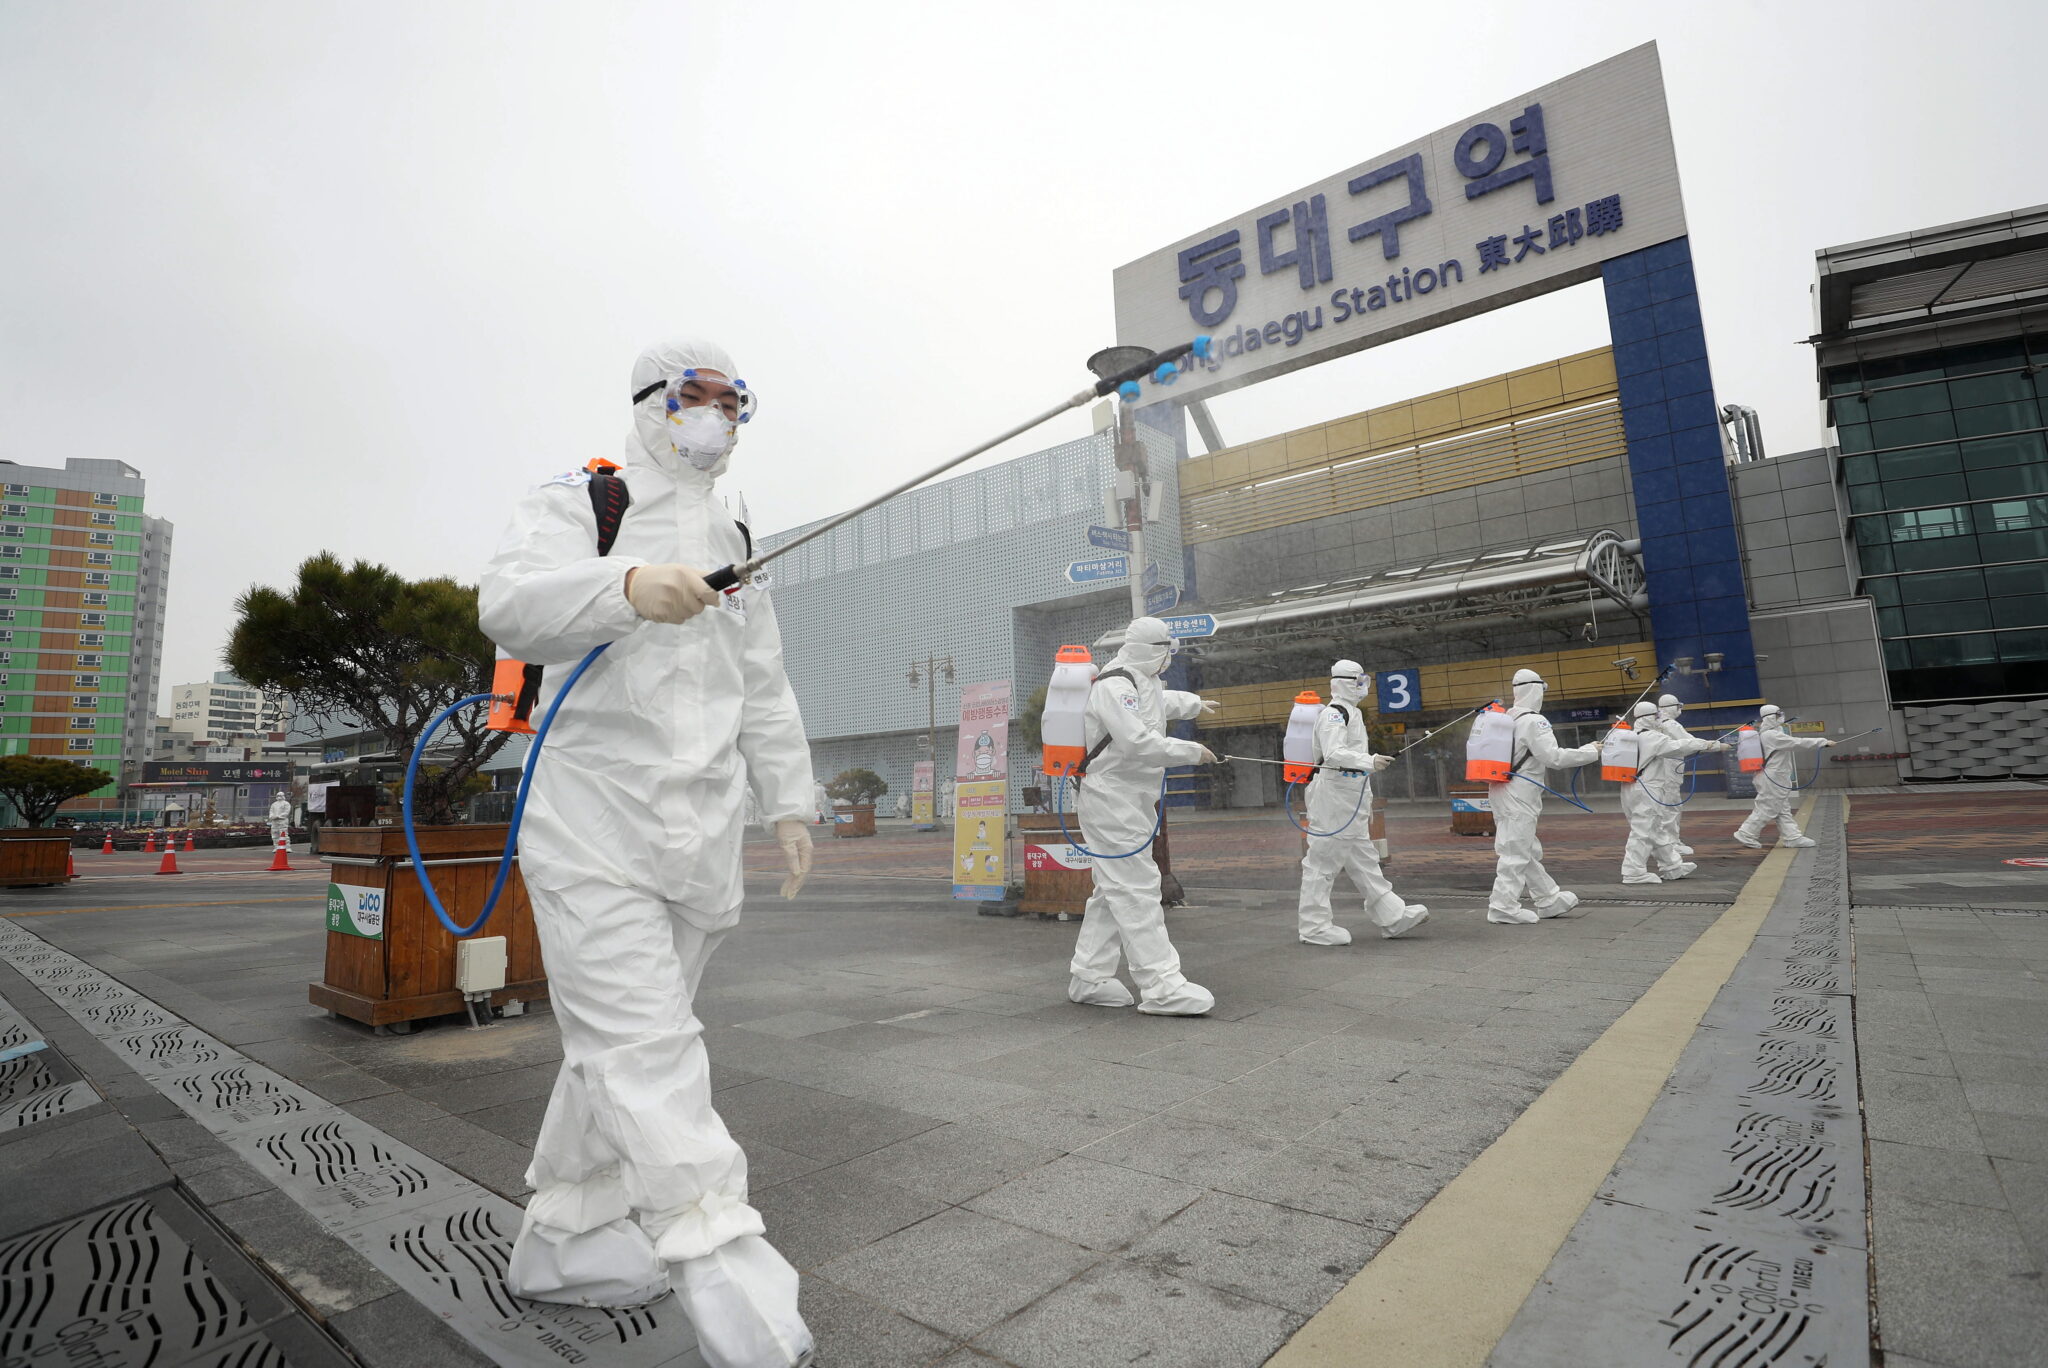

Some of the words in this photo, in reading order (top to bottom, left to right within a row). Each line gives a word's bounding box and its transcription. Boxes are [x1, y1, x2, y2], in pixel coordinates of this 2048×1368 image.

[1178, 102, 1555, 328] 동대구역
[1476, 193, 1623, 274] 東大邱驛
[1149, 305, 1323, 384] ongdaegu
[1331, 258, 1463, 323] Station
[754, 572, 769, 584] 현장
[1076, 560, 1122, 573] 파티마삼거리
[1387, 674, 1411, 709] 3
[962, 704, 1009, 721] 예방행동수칙
[160, 767, 183, 776] Motel
[185, 767, 209, 776] Shin
[222, 769, 241, 779] 모텔
[1737, 1258, 1782, 1315] Colorful
[536, 1332, 588, 1365] DAEGU
